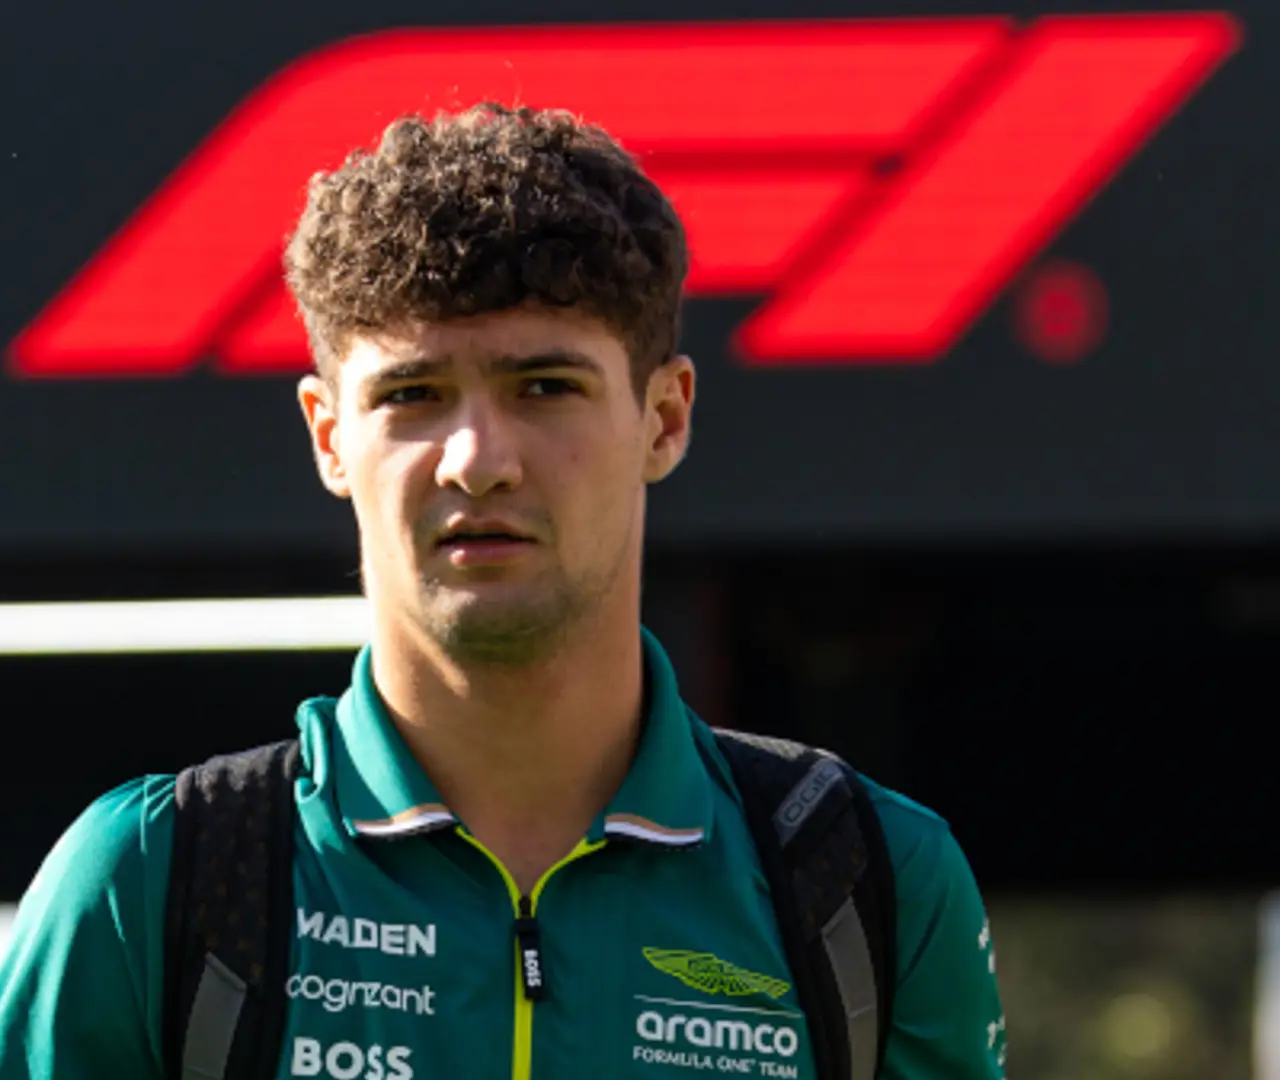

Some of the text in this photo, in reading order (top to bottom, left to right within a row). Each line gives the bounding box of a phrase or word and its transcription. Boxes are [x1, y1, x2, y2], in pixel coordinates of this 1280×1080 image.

[7, 12, 1242, 379] F1
[285, 974, 436, 1015] cognzant
[636, 1011, 798, 1056] aramco
[633, 1046, 714, 1070] FORMULA
[759, 1061, 798, 1079] TEAM
